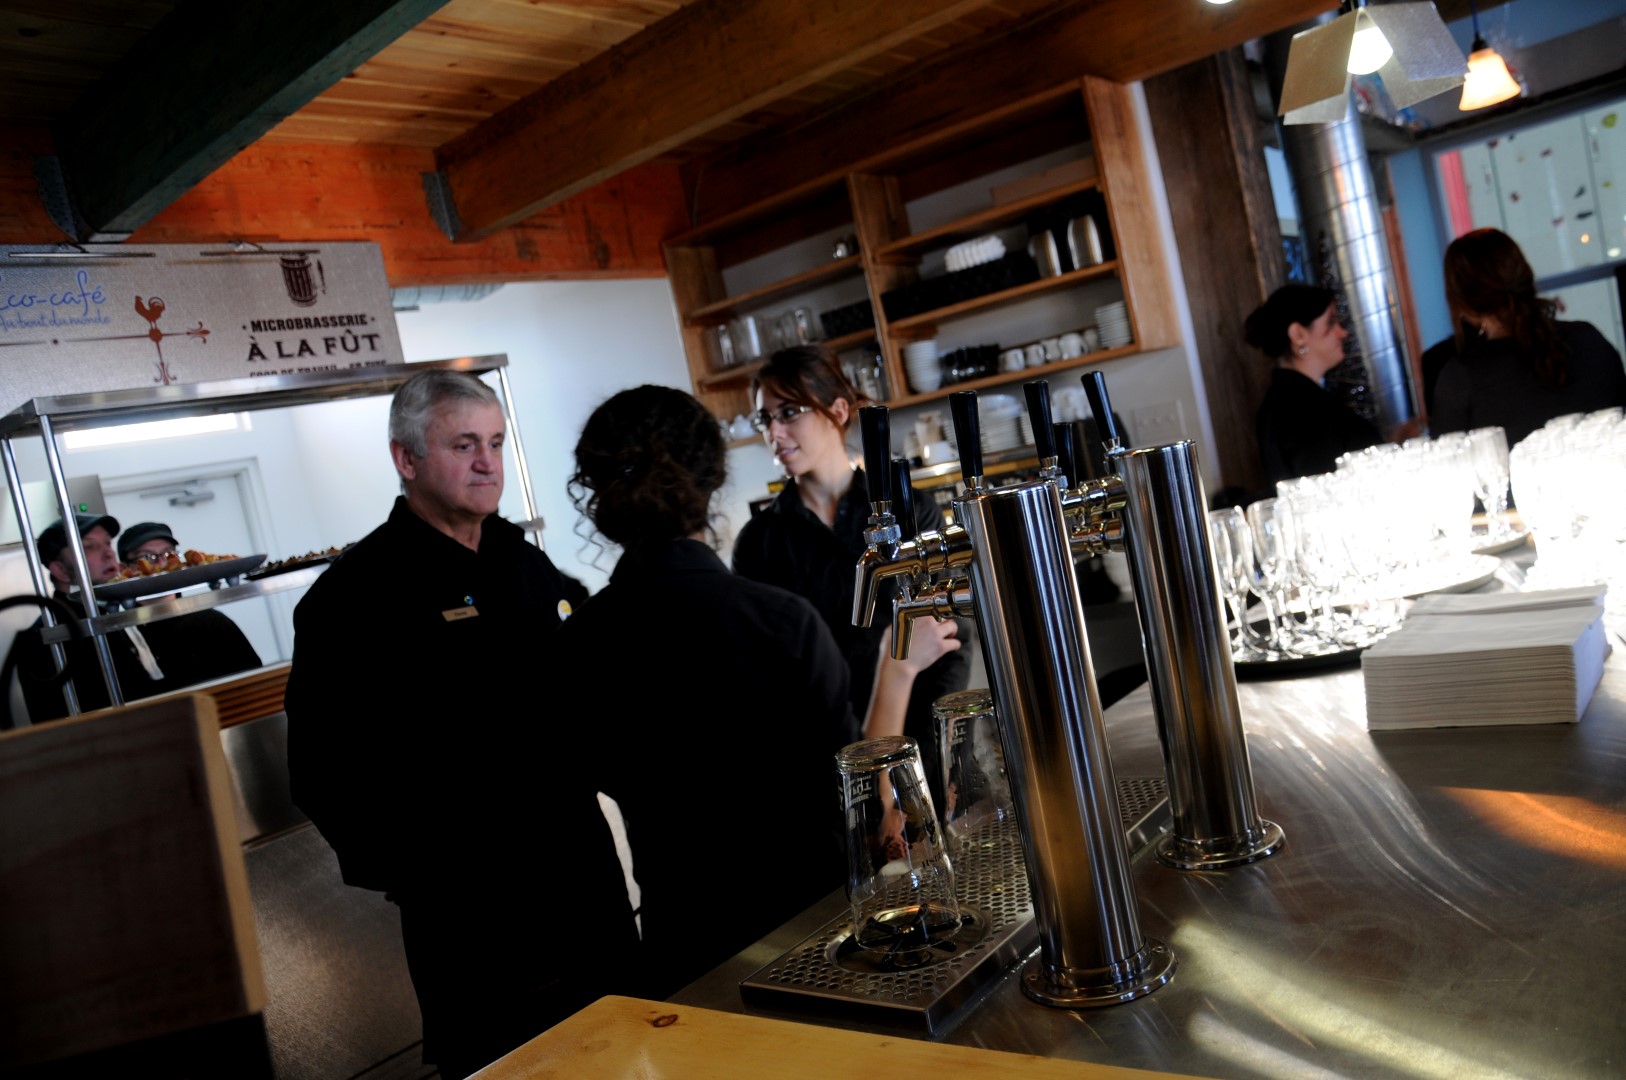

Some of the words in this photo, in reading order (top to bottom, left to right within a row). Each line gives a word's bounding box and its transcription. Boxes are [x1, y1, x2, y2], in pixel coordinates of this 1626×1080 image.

[250, 314, 368, 332] MICROBRASSERIE
[248, 335, 268, 361] À
[275, 338, 316, 359] LA
[323, 329, 380, 355] FÛT
